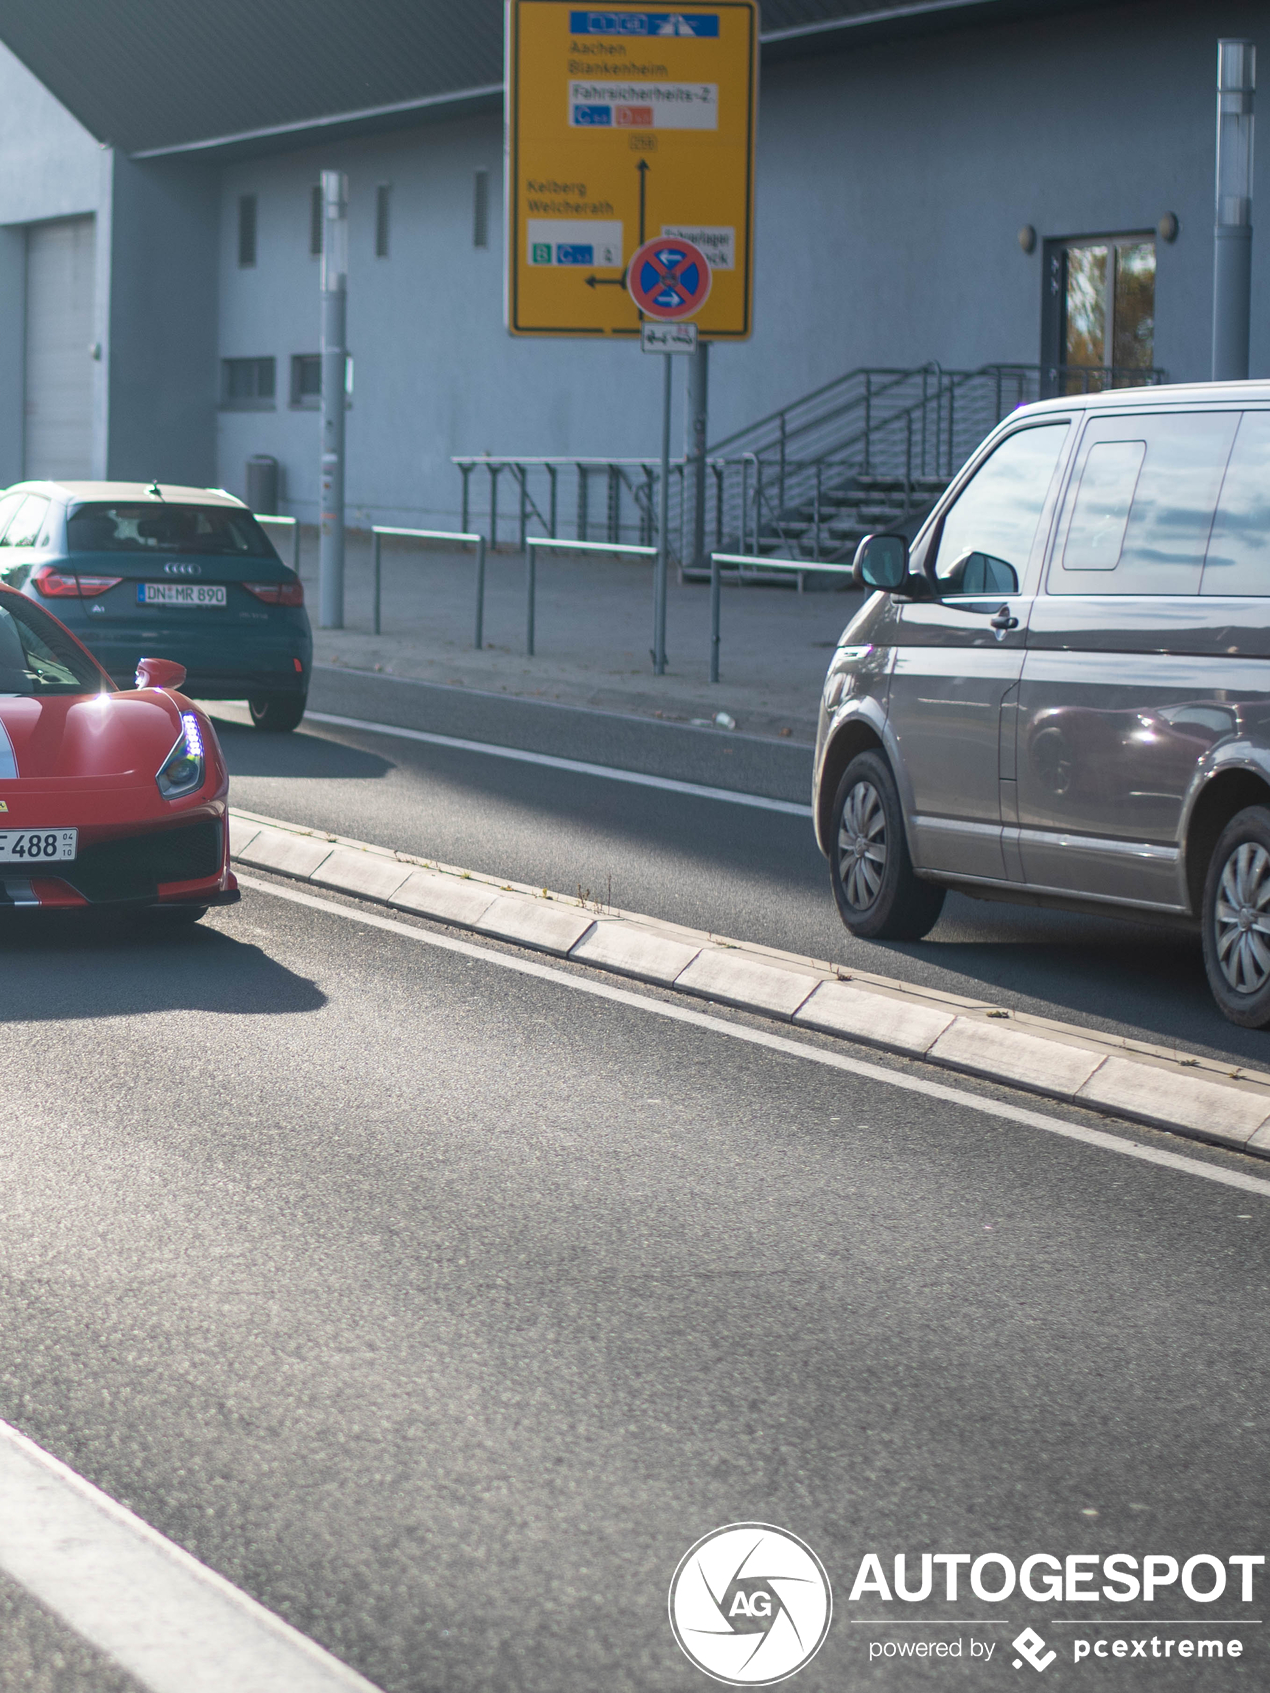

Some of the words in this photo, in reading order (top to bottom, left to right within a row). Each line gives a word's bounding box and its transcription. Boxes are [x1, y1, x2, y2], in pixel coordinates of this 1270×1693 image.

[570, 41, 627, 56] Aachen
[568, 60, 668, 77] Blankenheim
[527, 180, 587, 198] Kelberg
[527, 200, 614, 215] Welcherath
[665, 229, 729, 248] Fhrerlager
[147, 586, 165, 600] DN
[175, 587, 194, 602] MR
[197, 587, 224, 603] 890
[11, 833, 57, 858] 488
[62, 833, 73, 841] 04
[62, 848, 72, 857] 10
